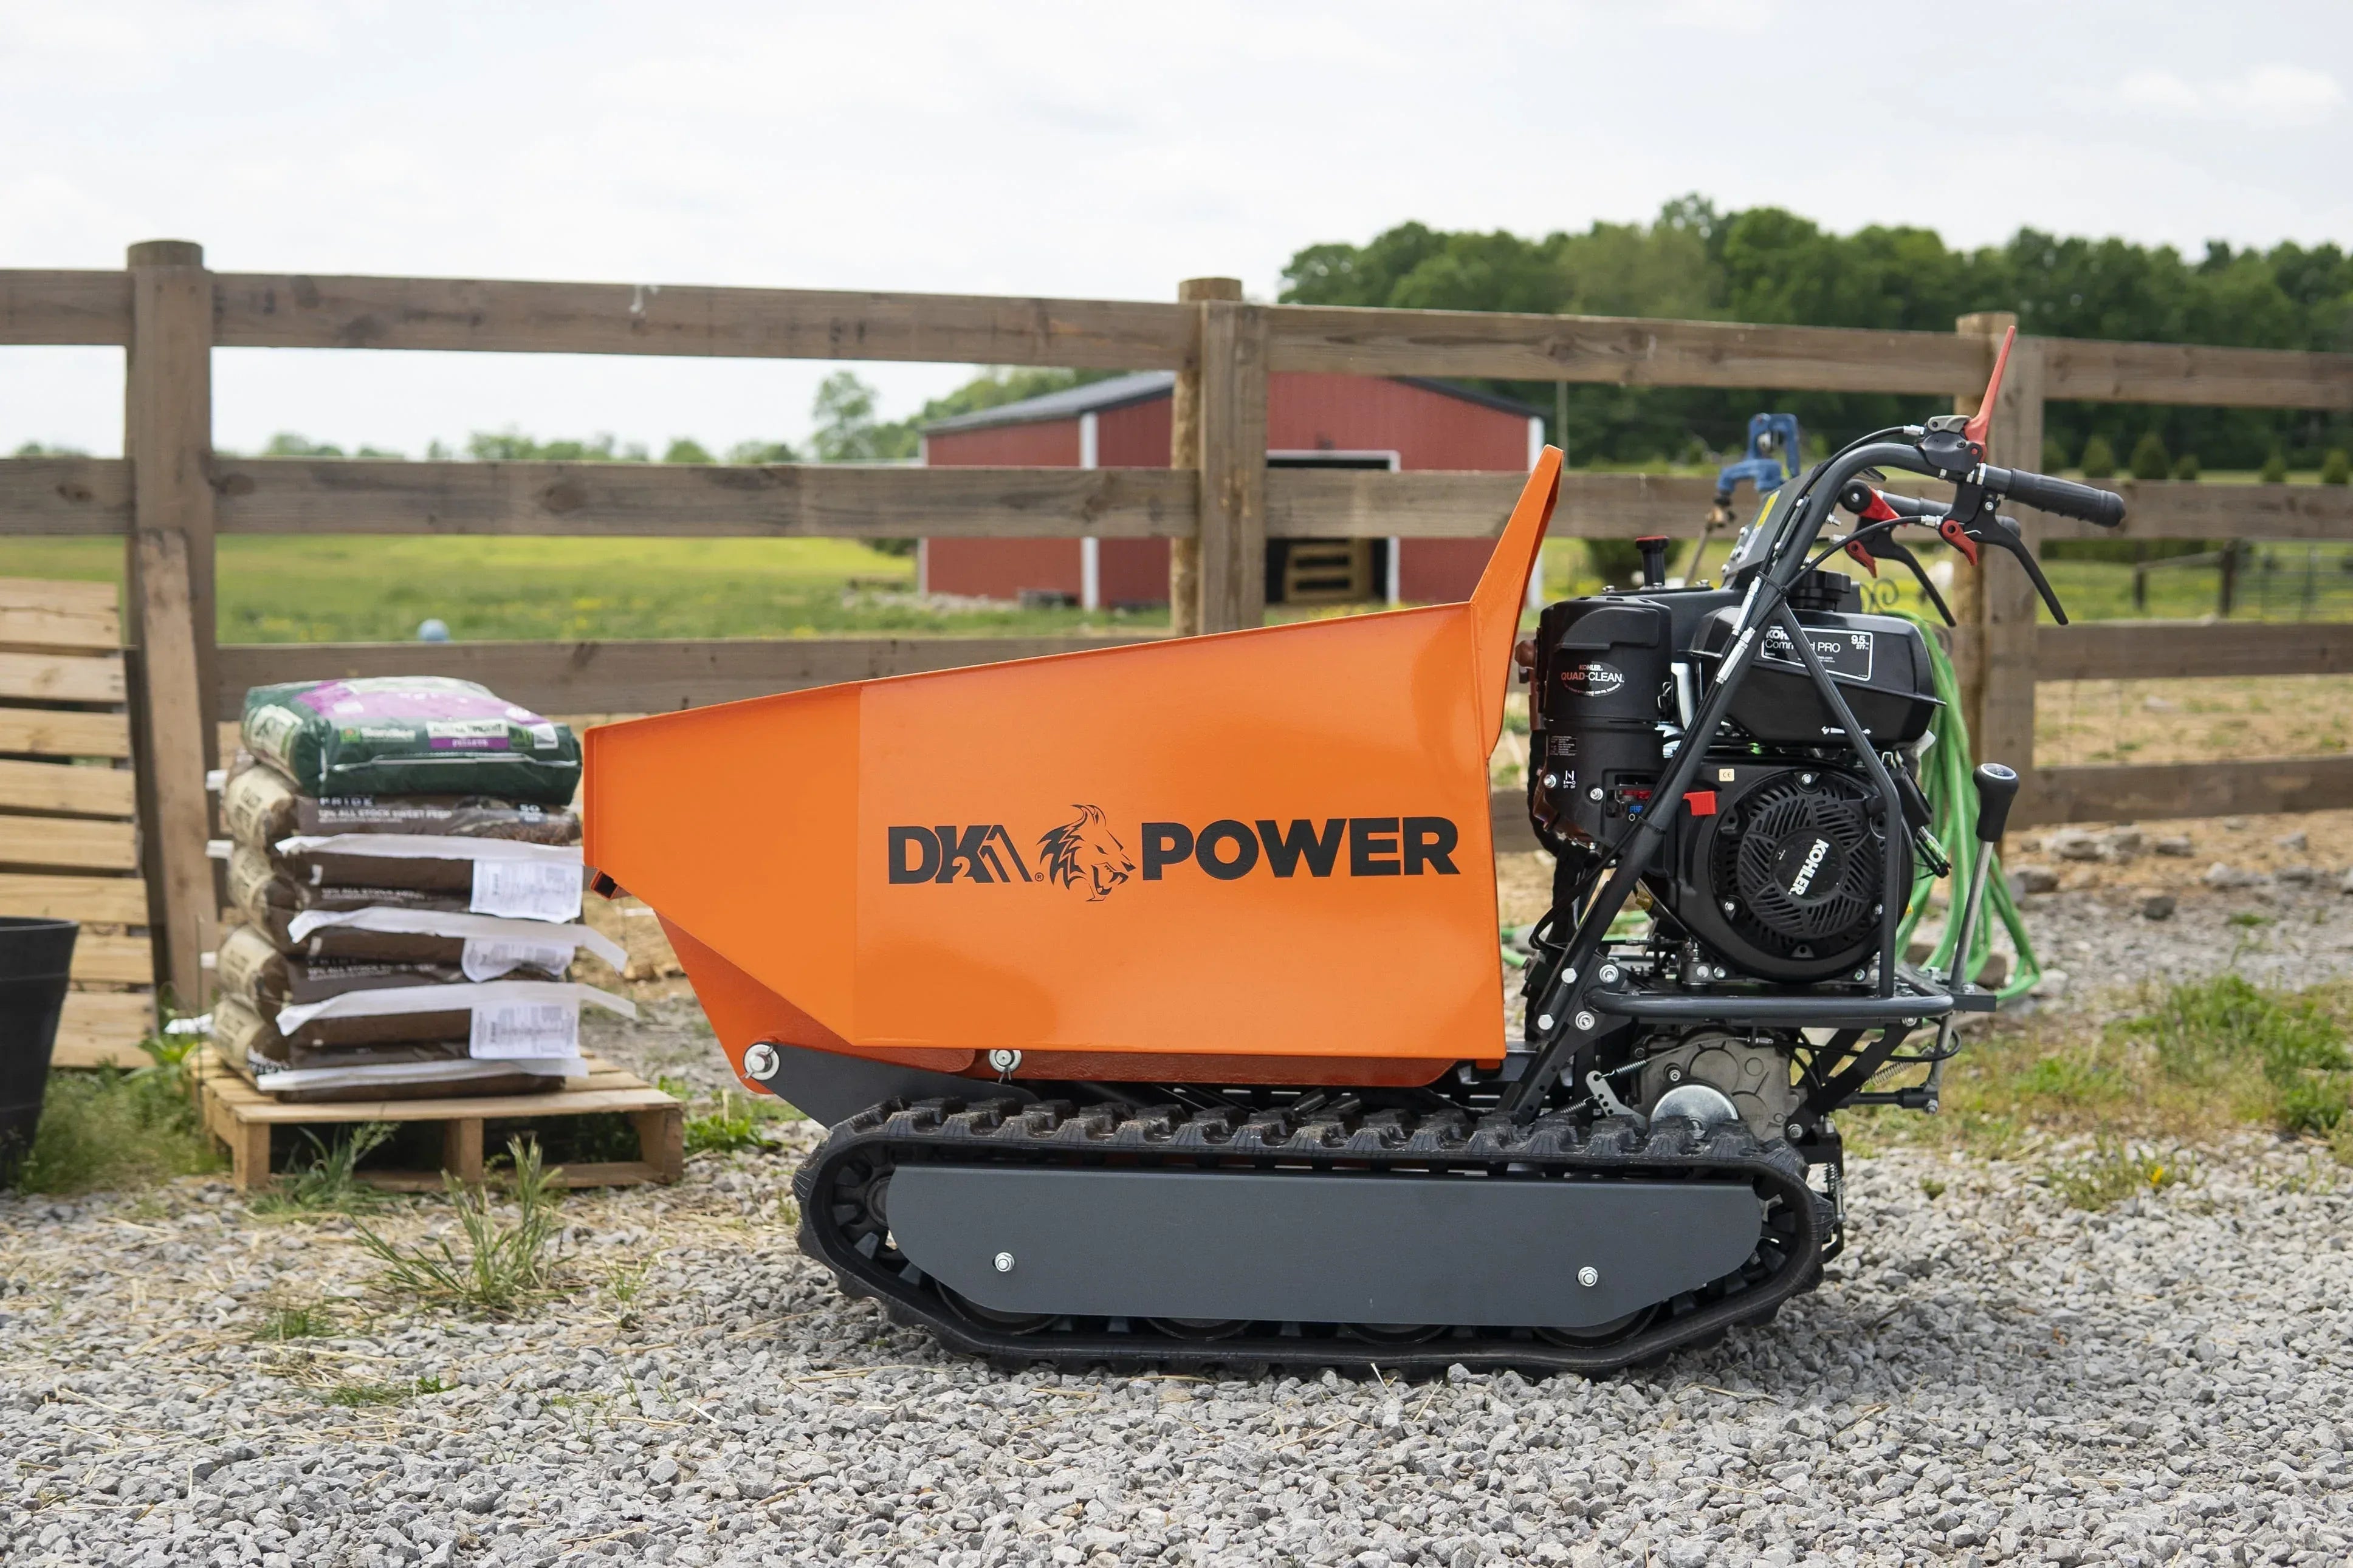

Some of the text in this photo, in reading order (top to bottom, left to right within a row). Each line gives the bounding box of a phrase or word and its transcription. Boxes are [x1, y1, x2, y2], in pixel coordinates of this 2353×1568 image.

[1818, 642, 1841, 653] PRO
[1561, 671, 1623, 683] QUAD-CLEAN
[319, 796, 373, 807] PRIDE
[1141, 817, 1461, 881] POWER
[1788, 838, 1829, 895] KOHLER
